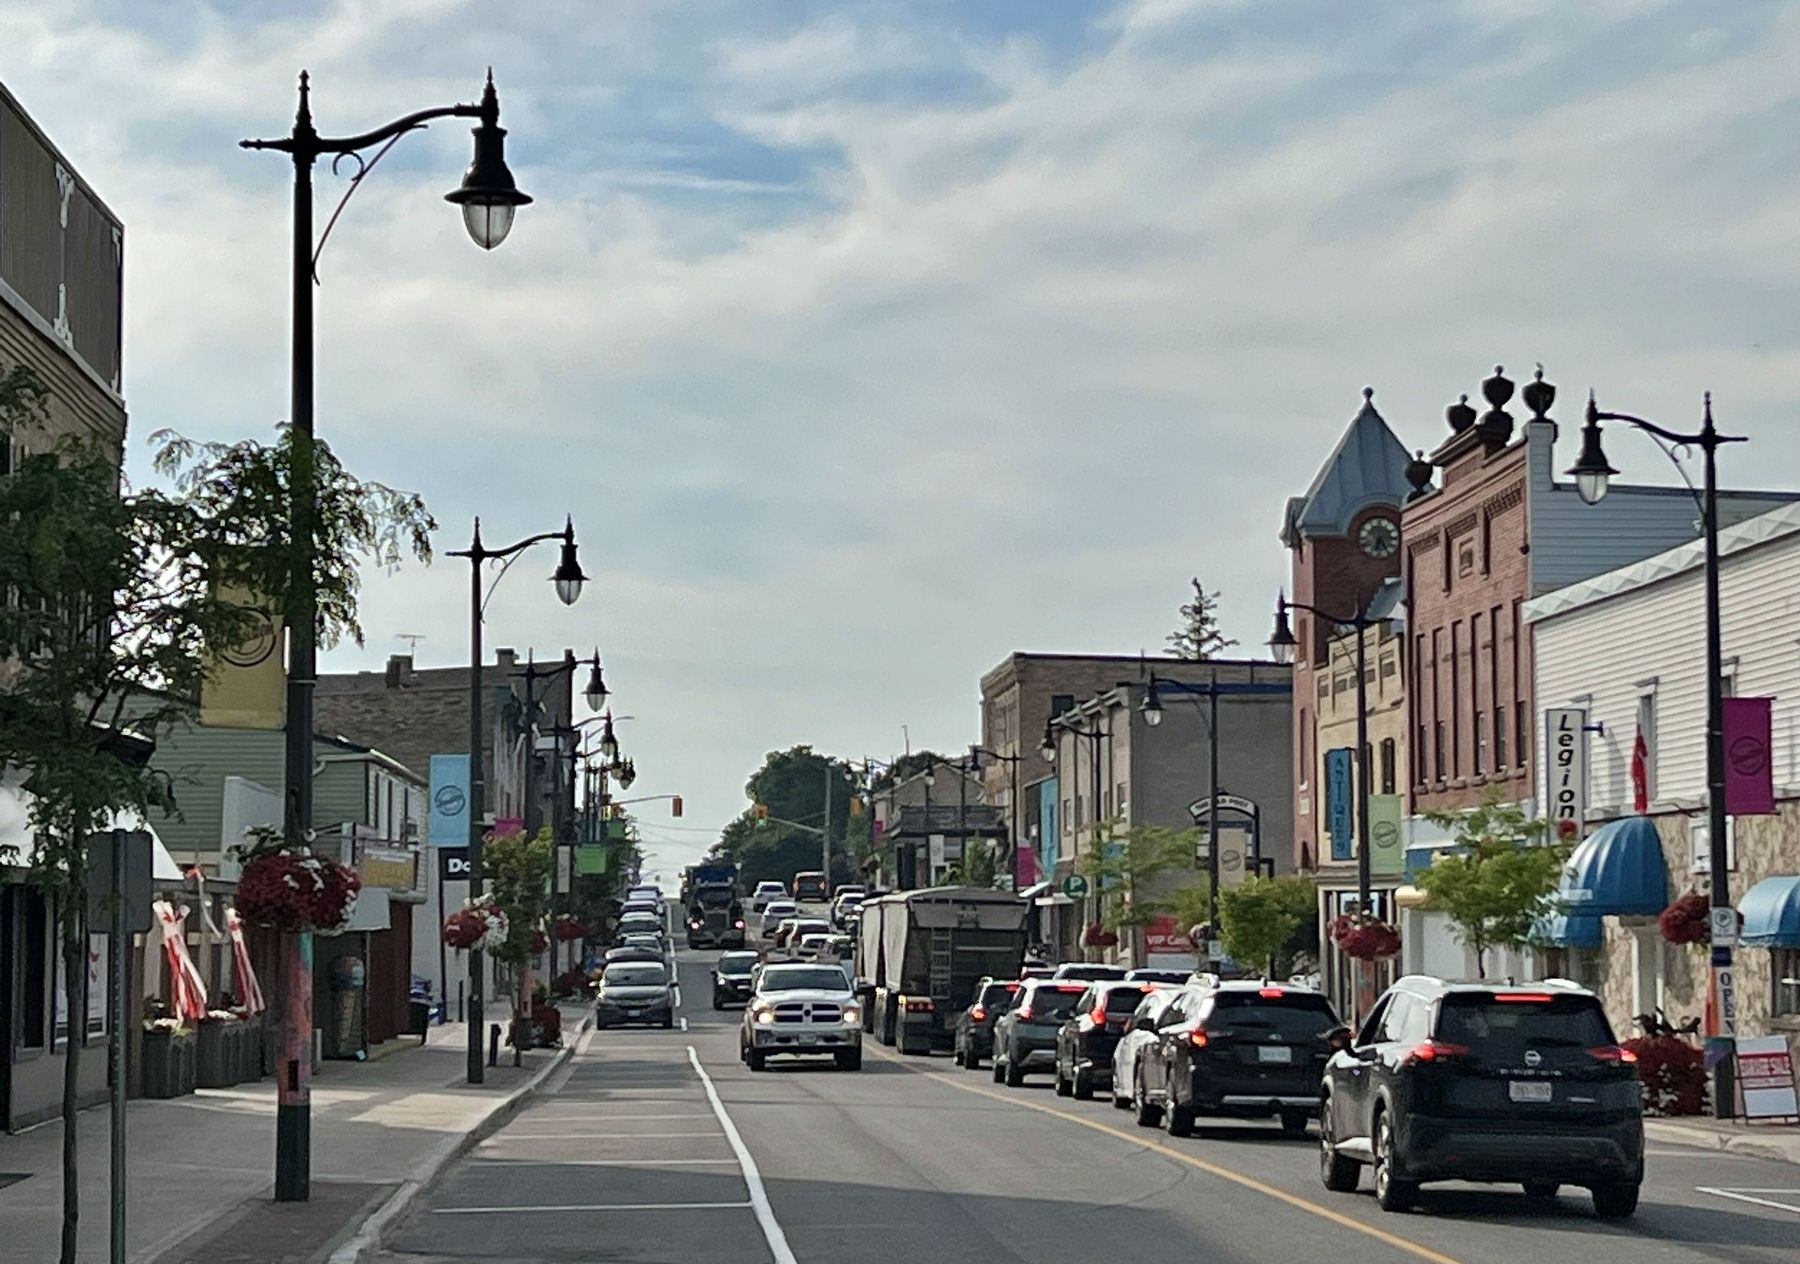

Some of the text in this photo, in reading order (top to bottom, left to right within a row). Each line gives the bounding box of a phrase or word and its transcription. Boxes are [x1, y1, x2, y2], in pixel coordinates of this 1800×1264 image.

[1333, 757, 1346, 853] ANTIQUES
[1557, 714, 1575, 818] Legion
[448, 858, 471, 872] Do
[1720, 971, 1735, 1034] OPEN
